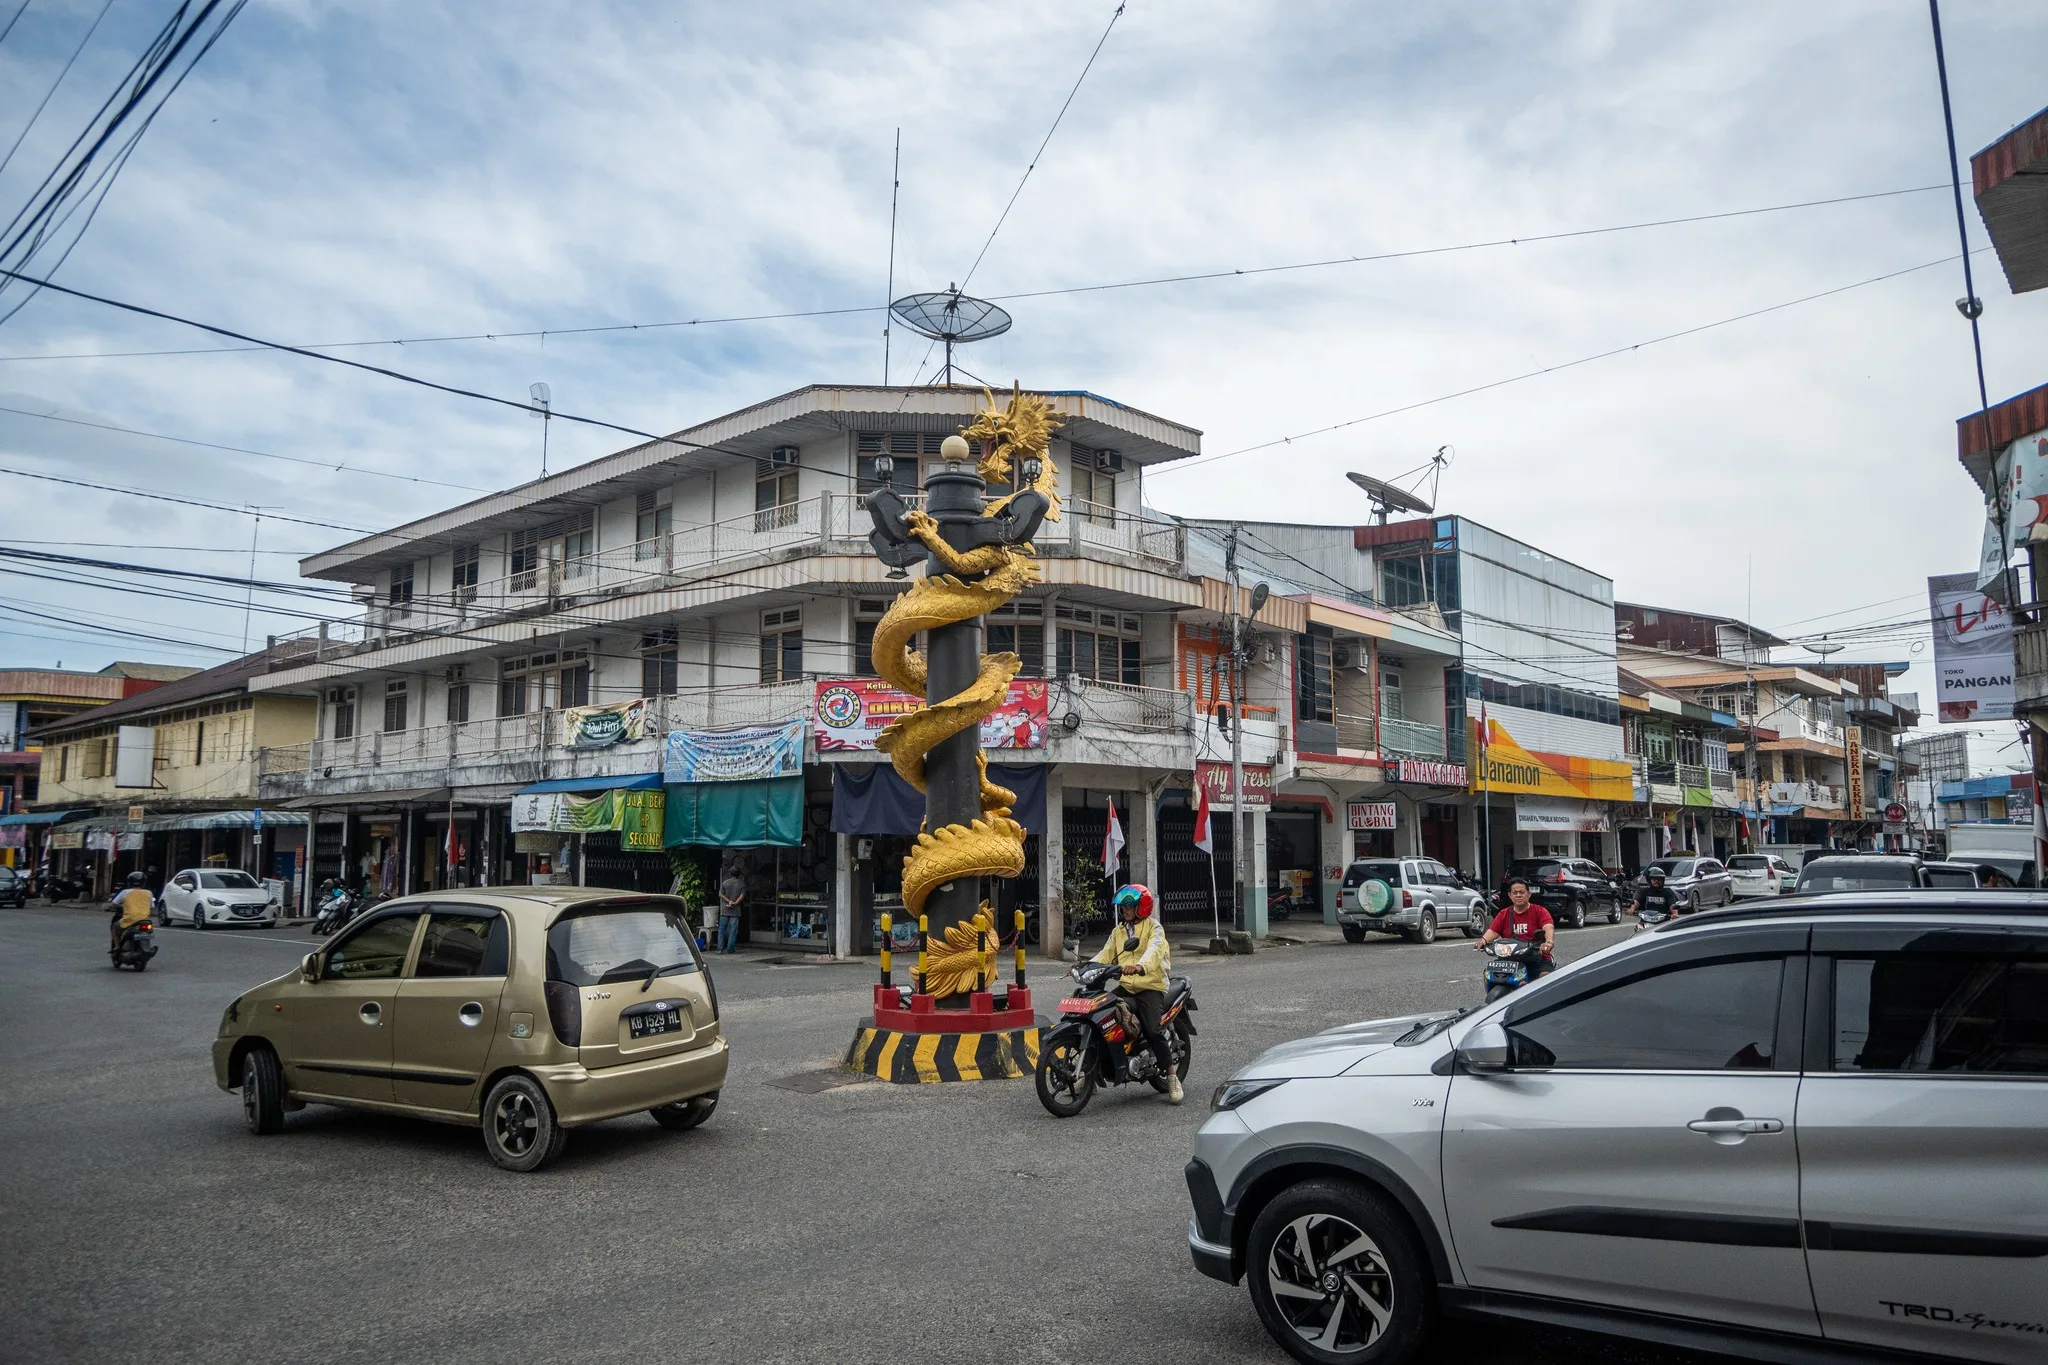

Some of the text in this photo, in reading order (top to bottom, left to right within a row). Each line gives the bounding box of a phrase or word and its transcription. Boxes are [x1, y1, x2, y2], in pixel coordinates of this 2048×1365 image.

[1955, 597, 2003, 634] LA
[1945, 676, 2011, 690] PANGAN
[868, 701, 927, 715] DIRGA
[1850, 742, 1860, 775] ANEKA
[1207, 764, 1271, 793] Ay ress
[1403, 760, 1469, 786] BINTANG GLOBAL
[1479, 756, 1540, 786] Danamon
[627, 794, 646, 807] JUA
[1248, 794, 1264, 803] PESTA
[1852, 778, 1862, 819] TEKNIK
[1351, 804, 1394, 816] BINTANG
[1351, 816, 1394, 828] GLOBAL
[628, 832, 661, 846] SECOND
[630, 1011, 680, 1030] KB 1529 HL
[1879, 1300, 1954, 1322] TRD
